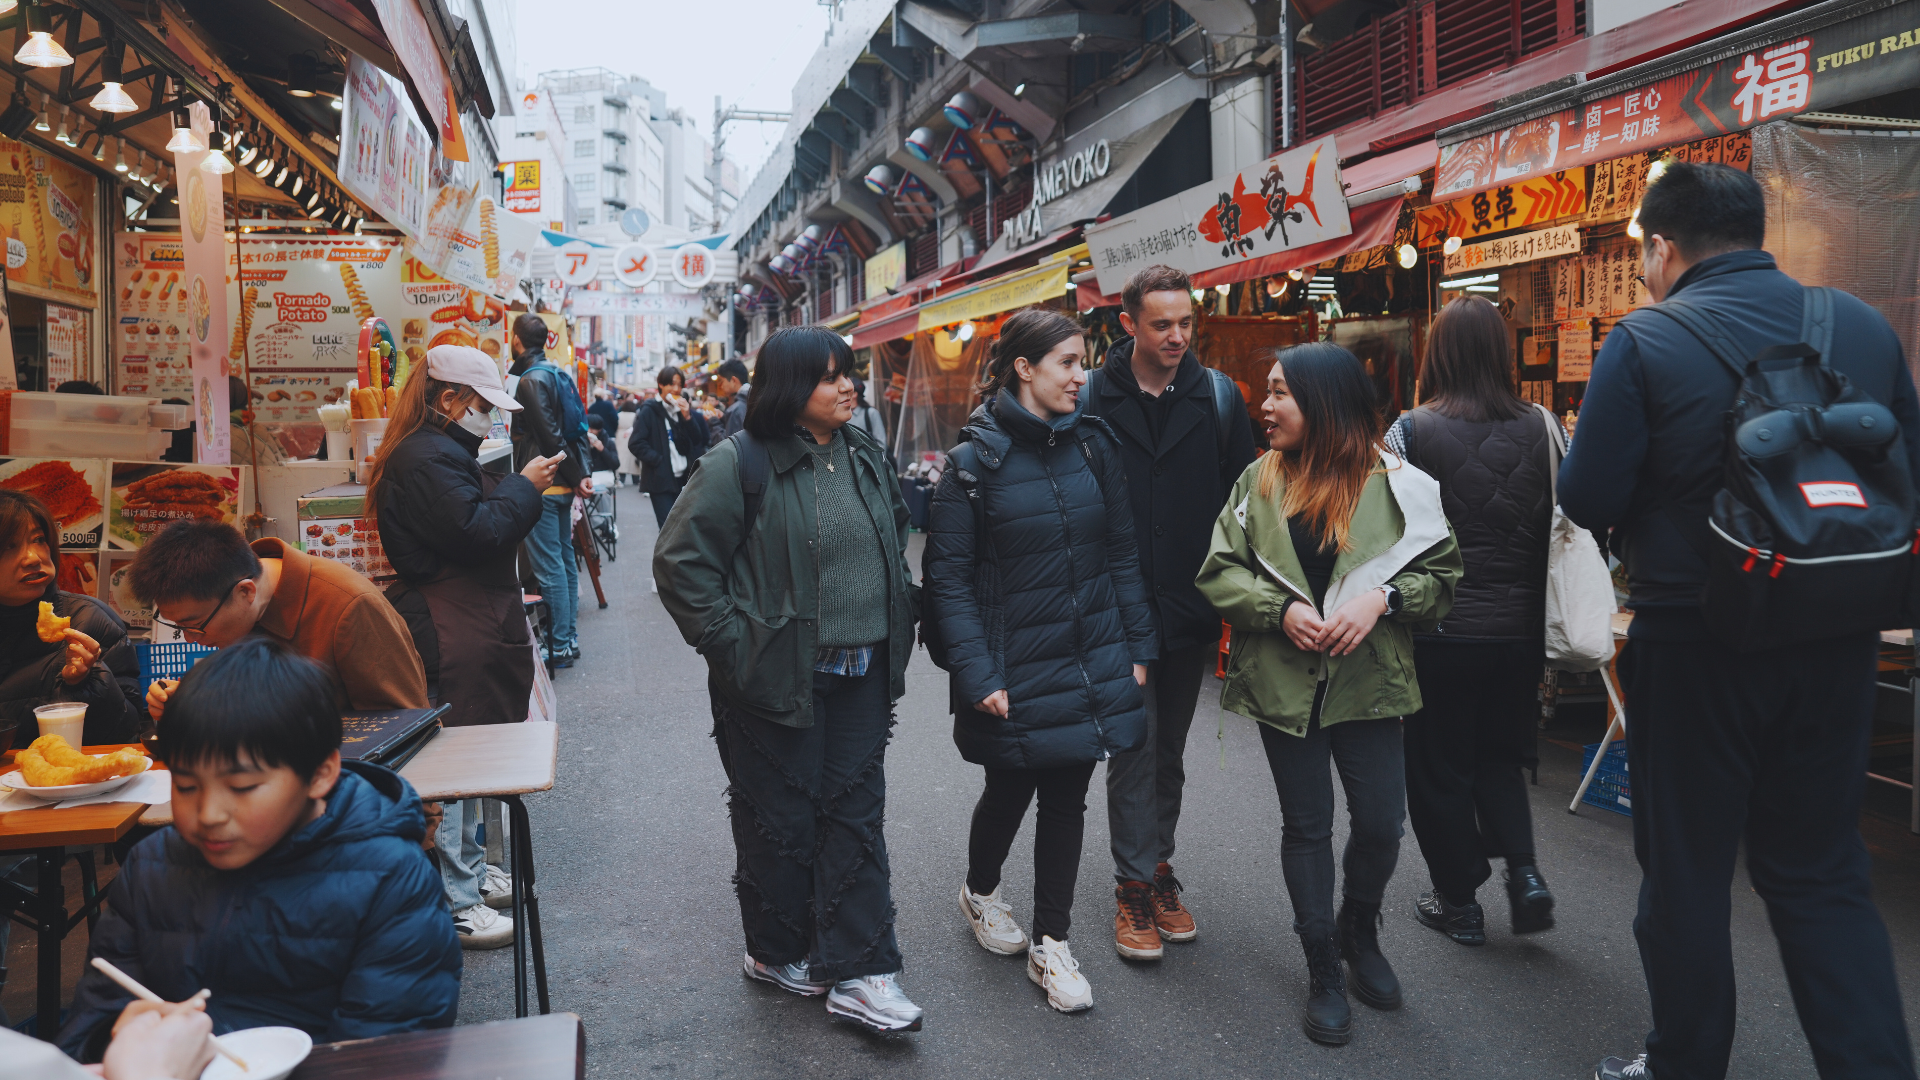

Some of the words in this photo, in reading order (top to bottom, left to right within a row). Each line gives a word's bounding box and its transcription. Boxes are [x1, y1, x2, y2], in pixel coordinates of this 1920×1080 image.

[1817, 42, 1875, 73] FUKU
[1734, 40, 1810, 123] 福
[518, 165, 536, 185] 薬
[1032, 138, 1110, 209] AMEYOKO
[1472, 186, 1517, 234] 魚草
[1003, 206, 1043, 244] PLAZA
[1099, 223, 1197, 269] 三陸の海の幸をお届けする
[154, 249, 184, 259] SNA
[229, 248, 325, 266] 日本1の長さ体験
[360, 261, 384, 270] ¥800
[565, 253, 706, 277] アメ横
[245, 279, 268, 288] ¥600
[256, 301, 272, 309] 40CM
[275, 294, 330, 307] Tornado
[280, 309, 326, 322] Potato
[332, 305, 350, 314] 50CM
[1810, 488, 1860, 499] HUNTER
[120, 508, 195, 520] 揚げ鶏足の煮込み
[62, 532, 97, 544] 500円
